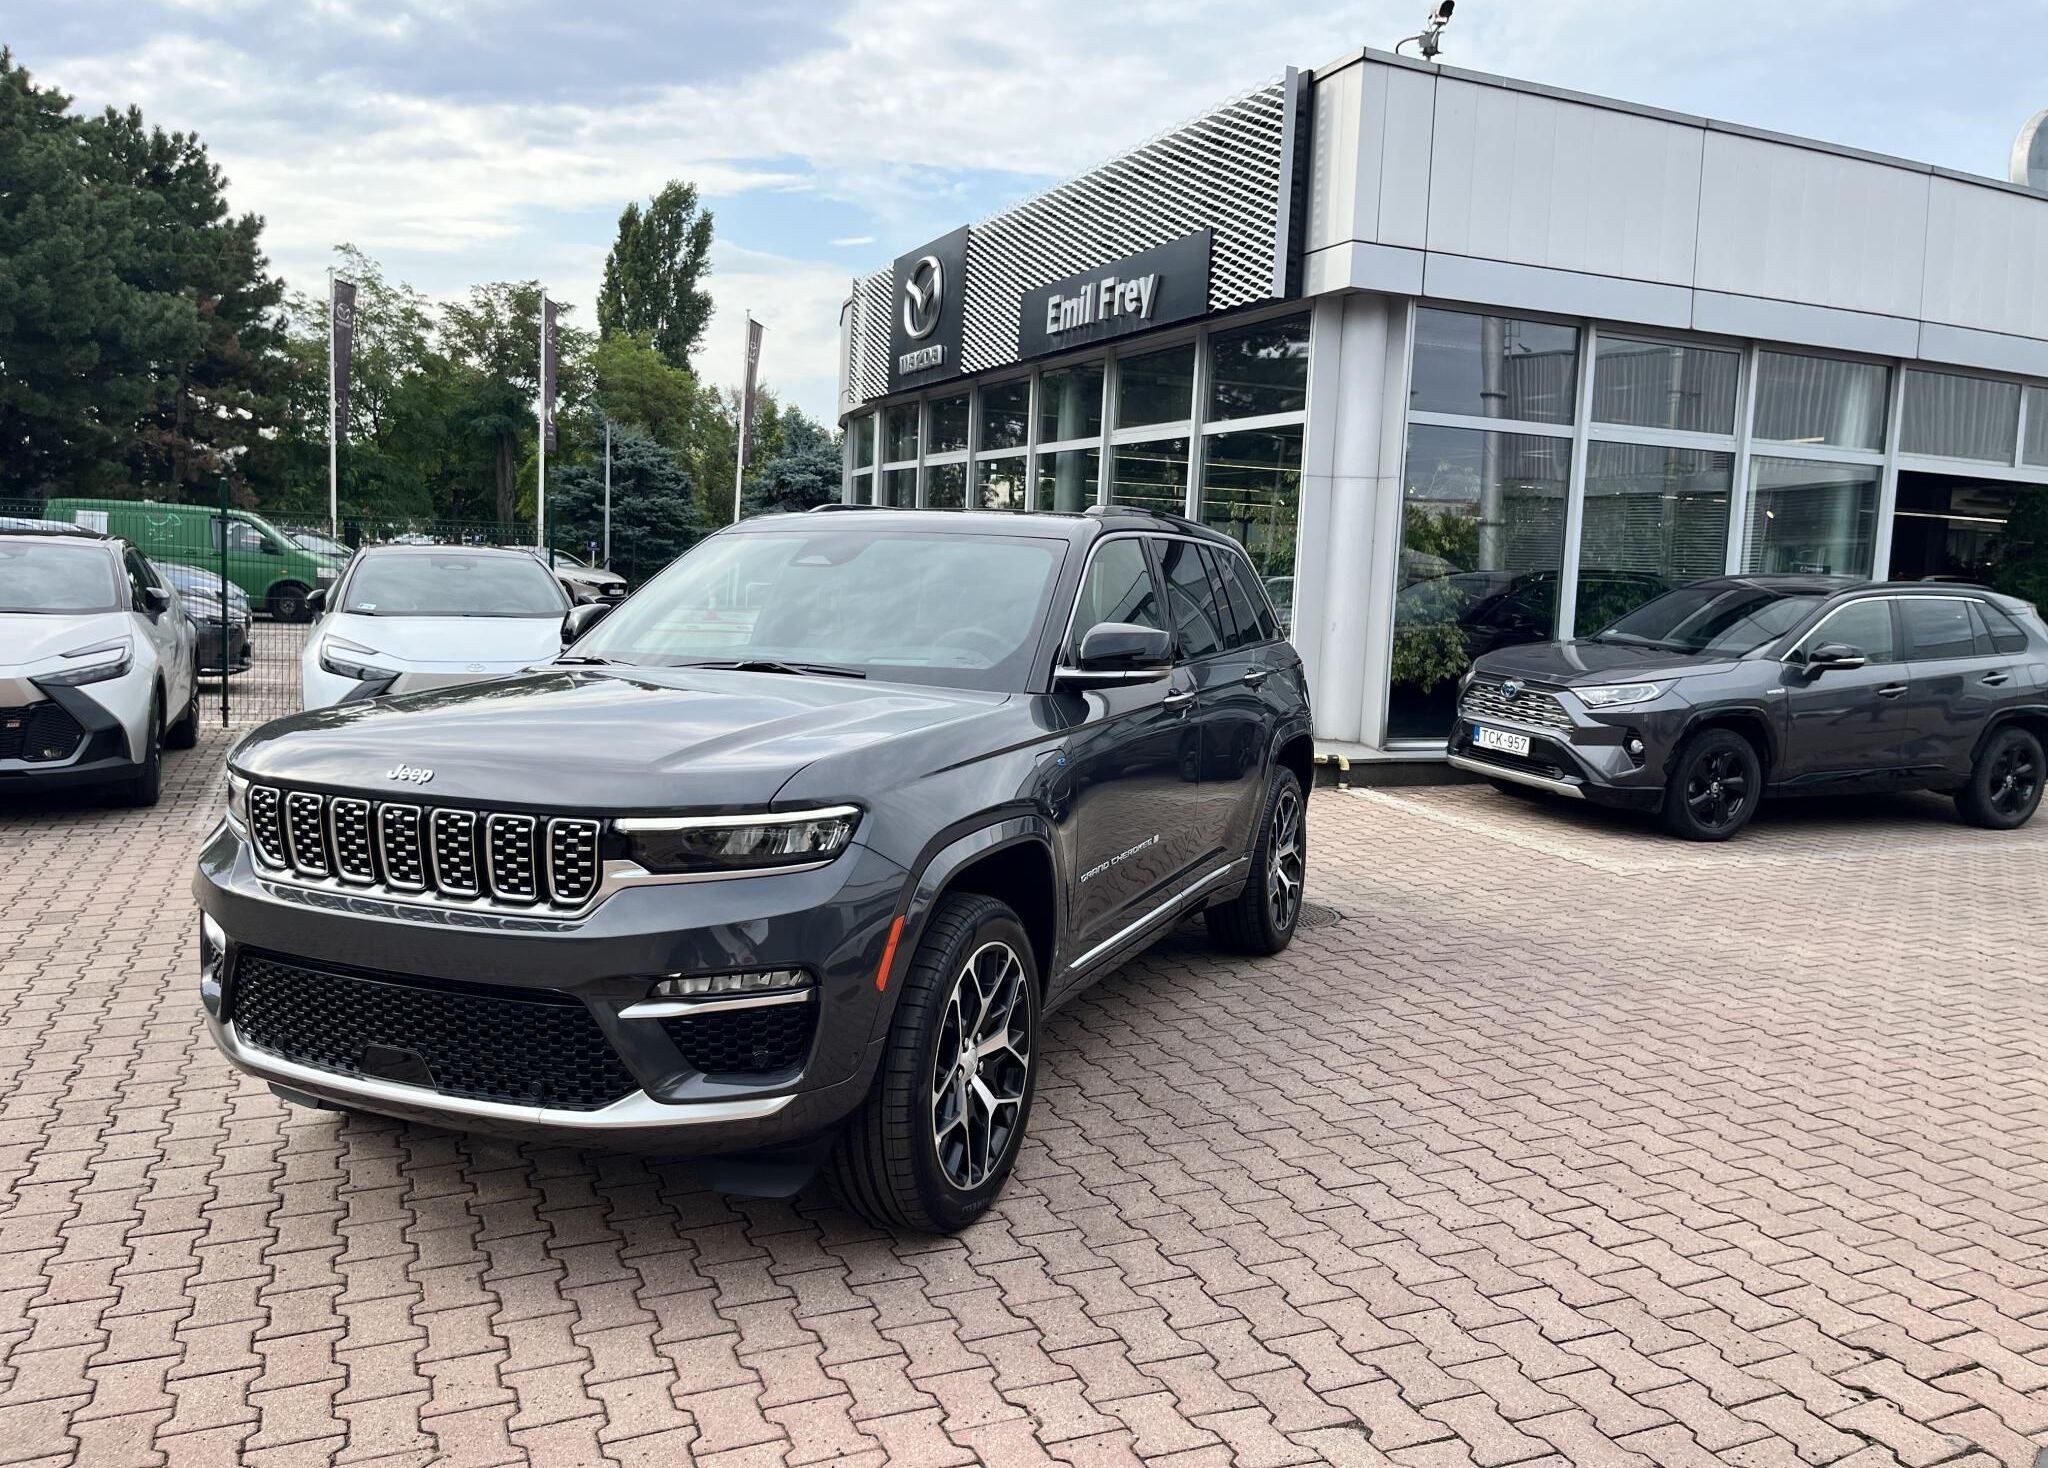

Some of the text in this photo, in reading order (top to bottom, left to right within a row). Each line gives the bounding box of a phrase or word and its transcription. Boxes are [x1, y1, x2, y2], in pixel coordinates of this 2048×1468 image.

[1046, 273, 1159, 334] Emil Frey
[1481, 729, 1527, 751] TCK-957
[387, 763, 434, 785] Jeep
[1080, 837, 1153, 883] GRAND CHEROKEE
